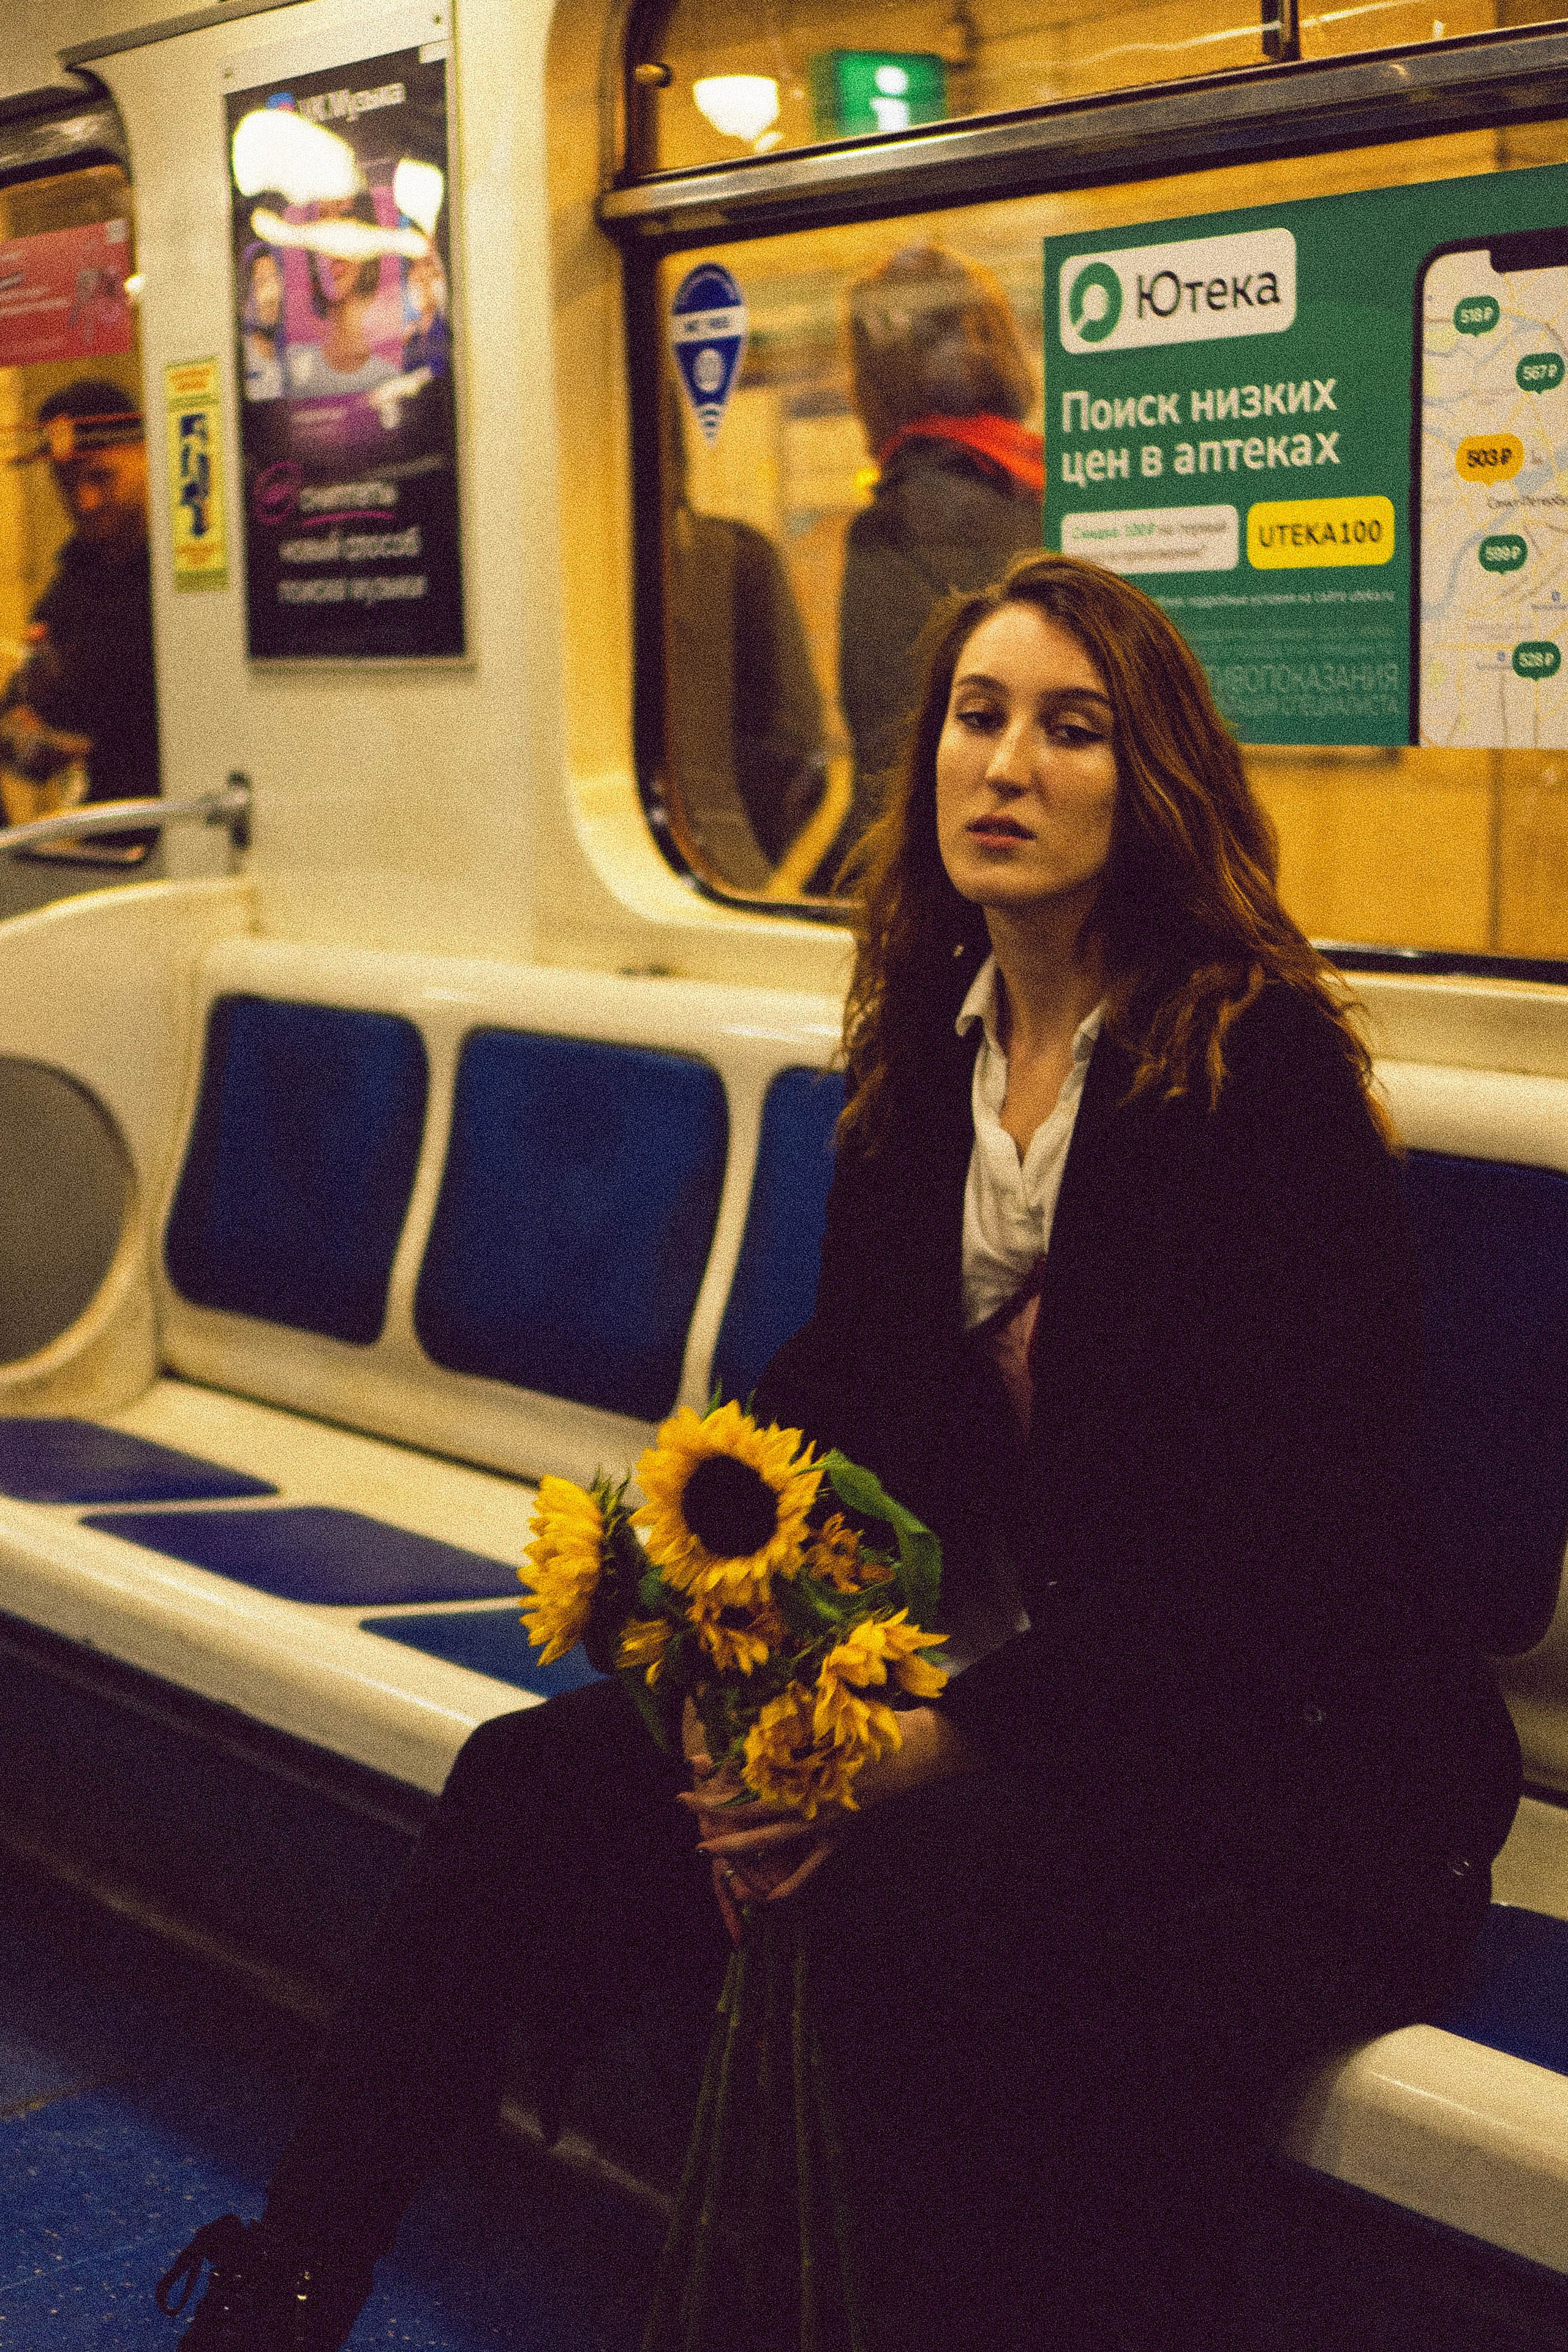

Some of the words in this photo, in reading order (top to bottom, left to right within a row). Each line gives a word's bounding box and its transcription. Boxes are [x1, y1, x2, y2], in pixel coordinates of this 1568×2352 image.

[1137, 271, 1281, 319] Ютека
[1062, 390, 1181, 432] Поиск
[1191, 378, 1338, 423] низких
[1062, 448, 1129, 488] цен
[1140, 446, 1163, 478] в
[1174, 432, 1341, 476] аптеках
[1258, 519, 1383, 549] UTEKA100
